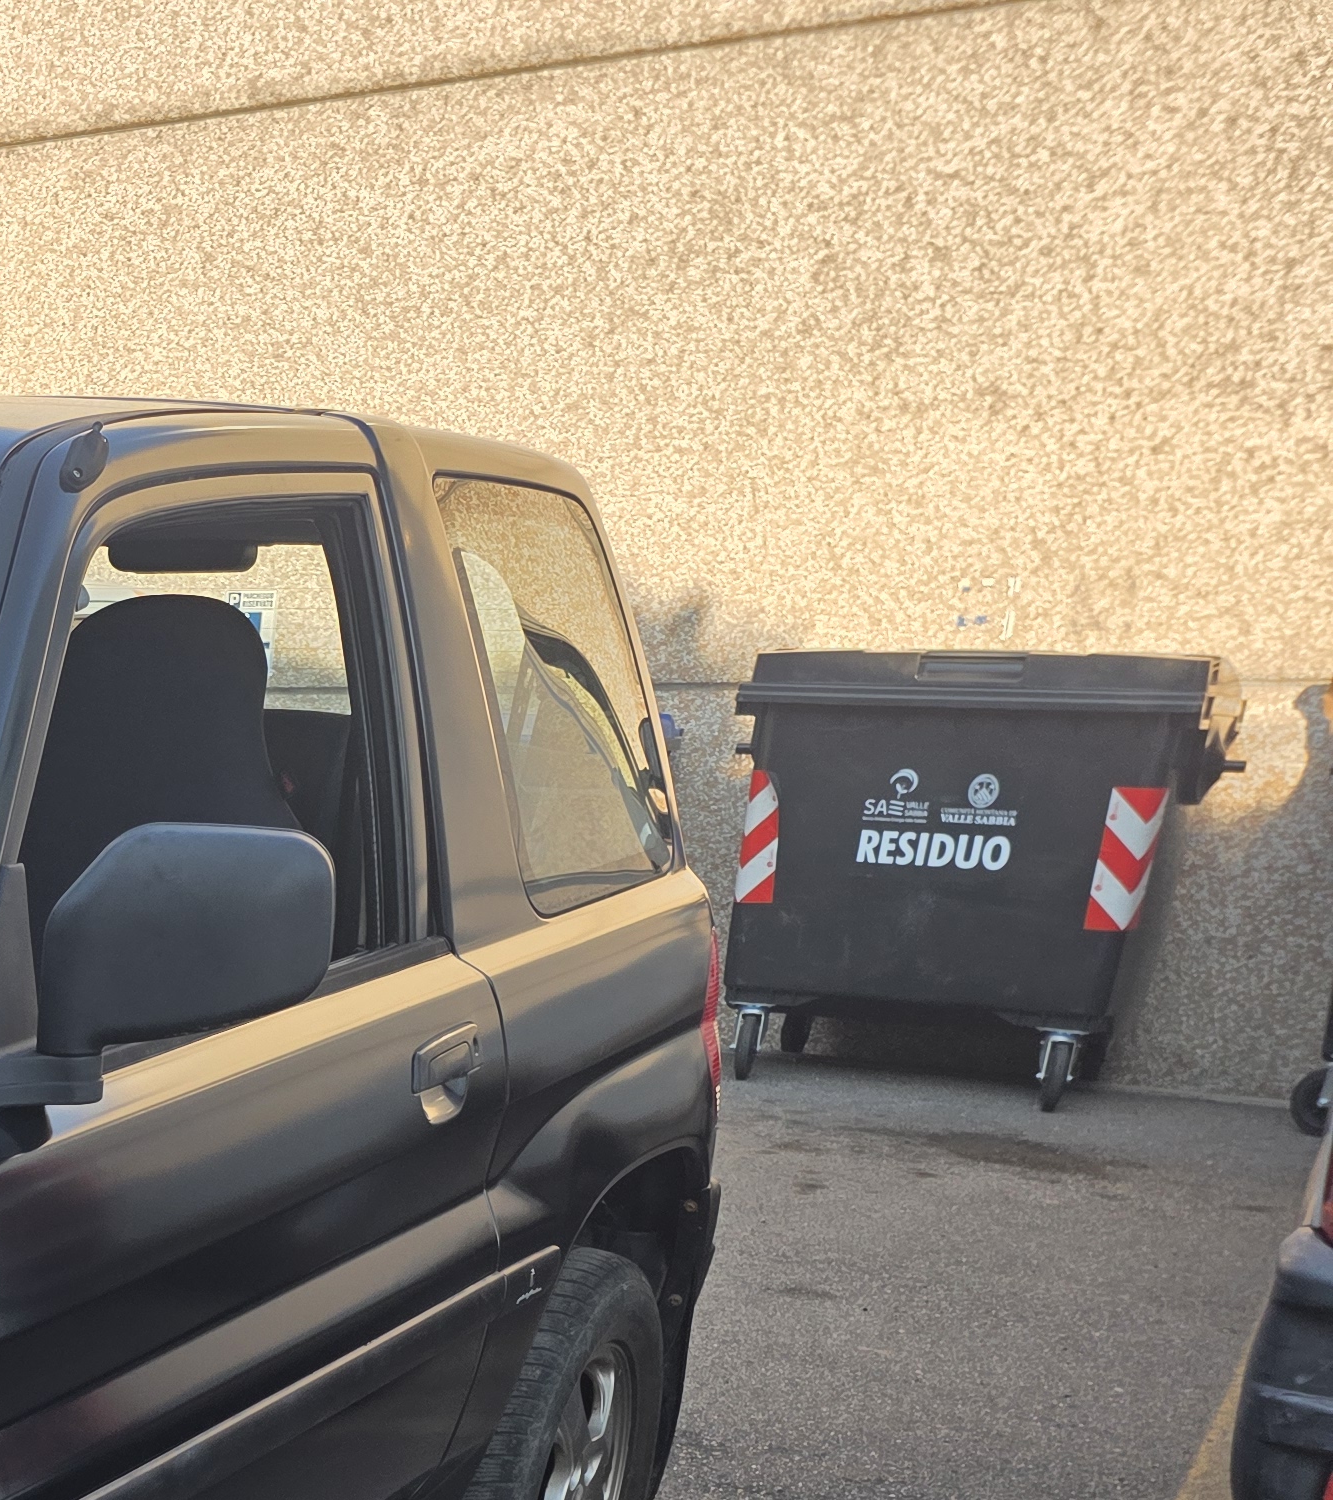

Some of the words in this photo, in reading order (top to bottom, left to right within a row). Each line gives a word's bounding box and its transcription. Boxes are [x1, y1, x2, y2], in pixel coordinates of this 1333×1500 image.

[940, 813, 973, 824] VALLE
[974, 815, 1016, 826] SABBIA
[856, 829, 1011, 871] RESIDUO
